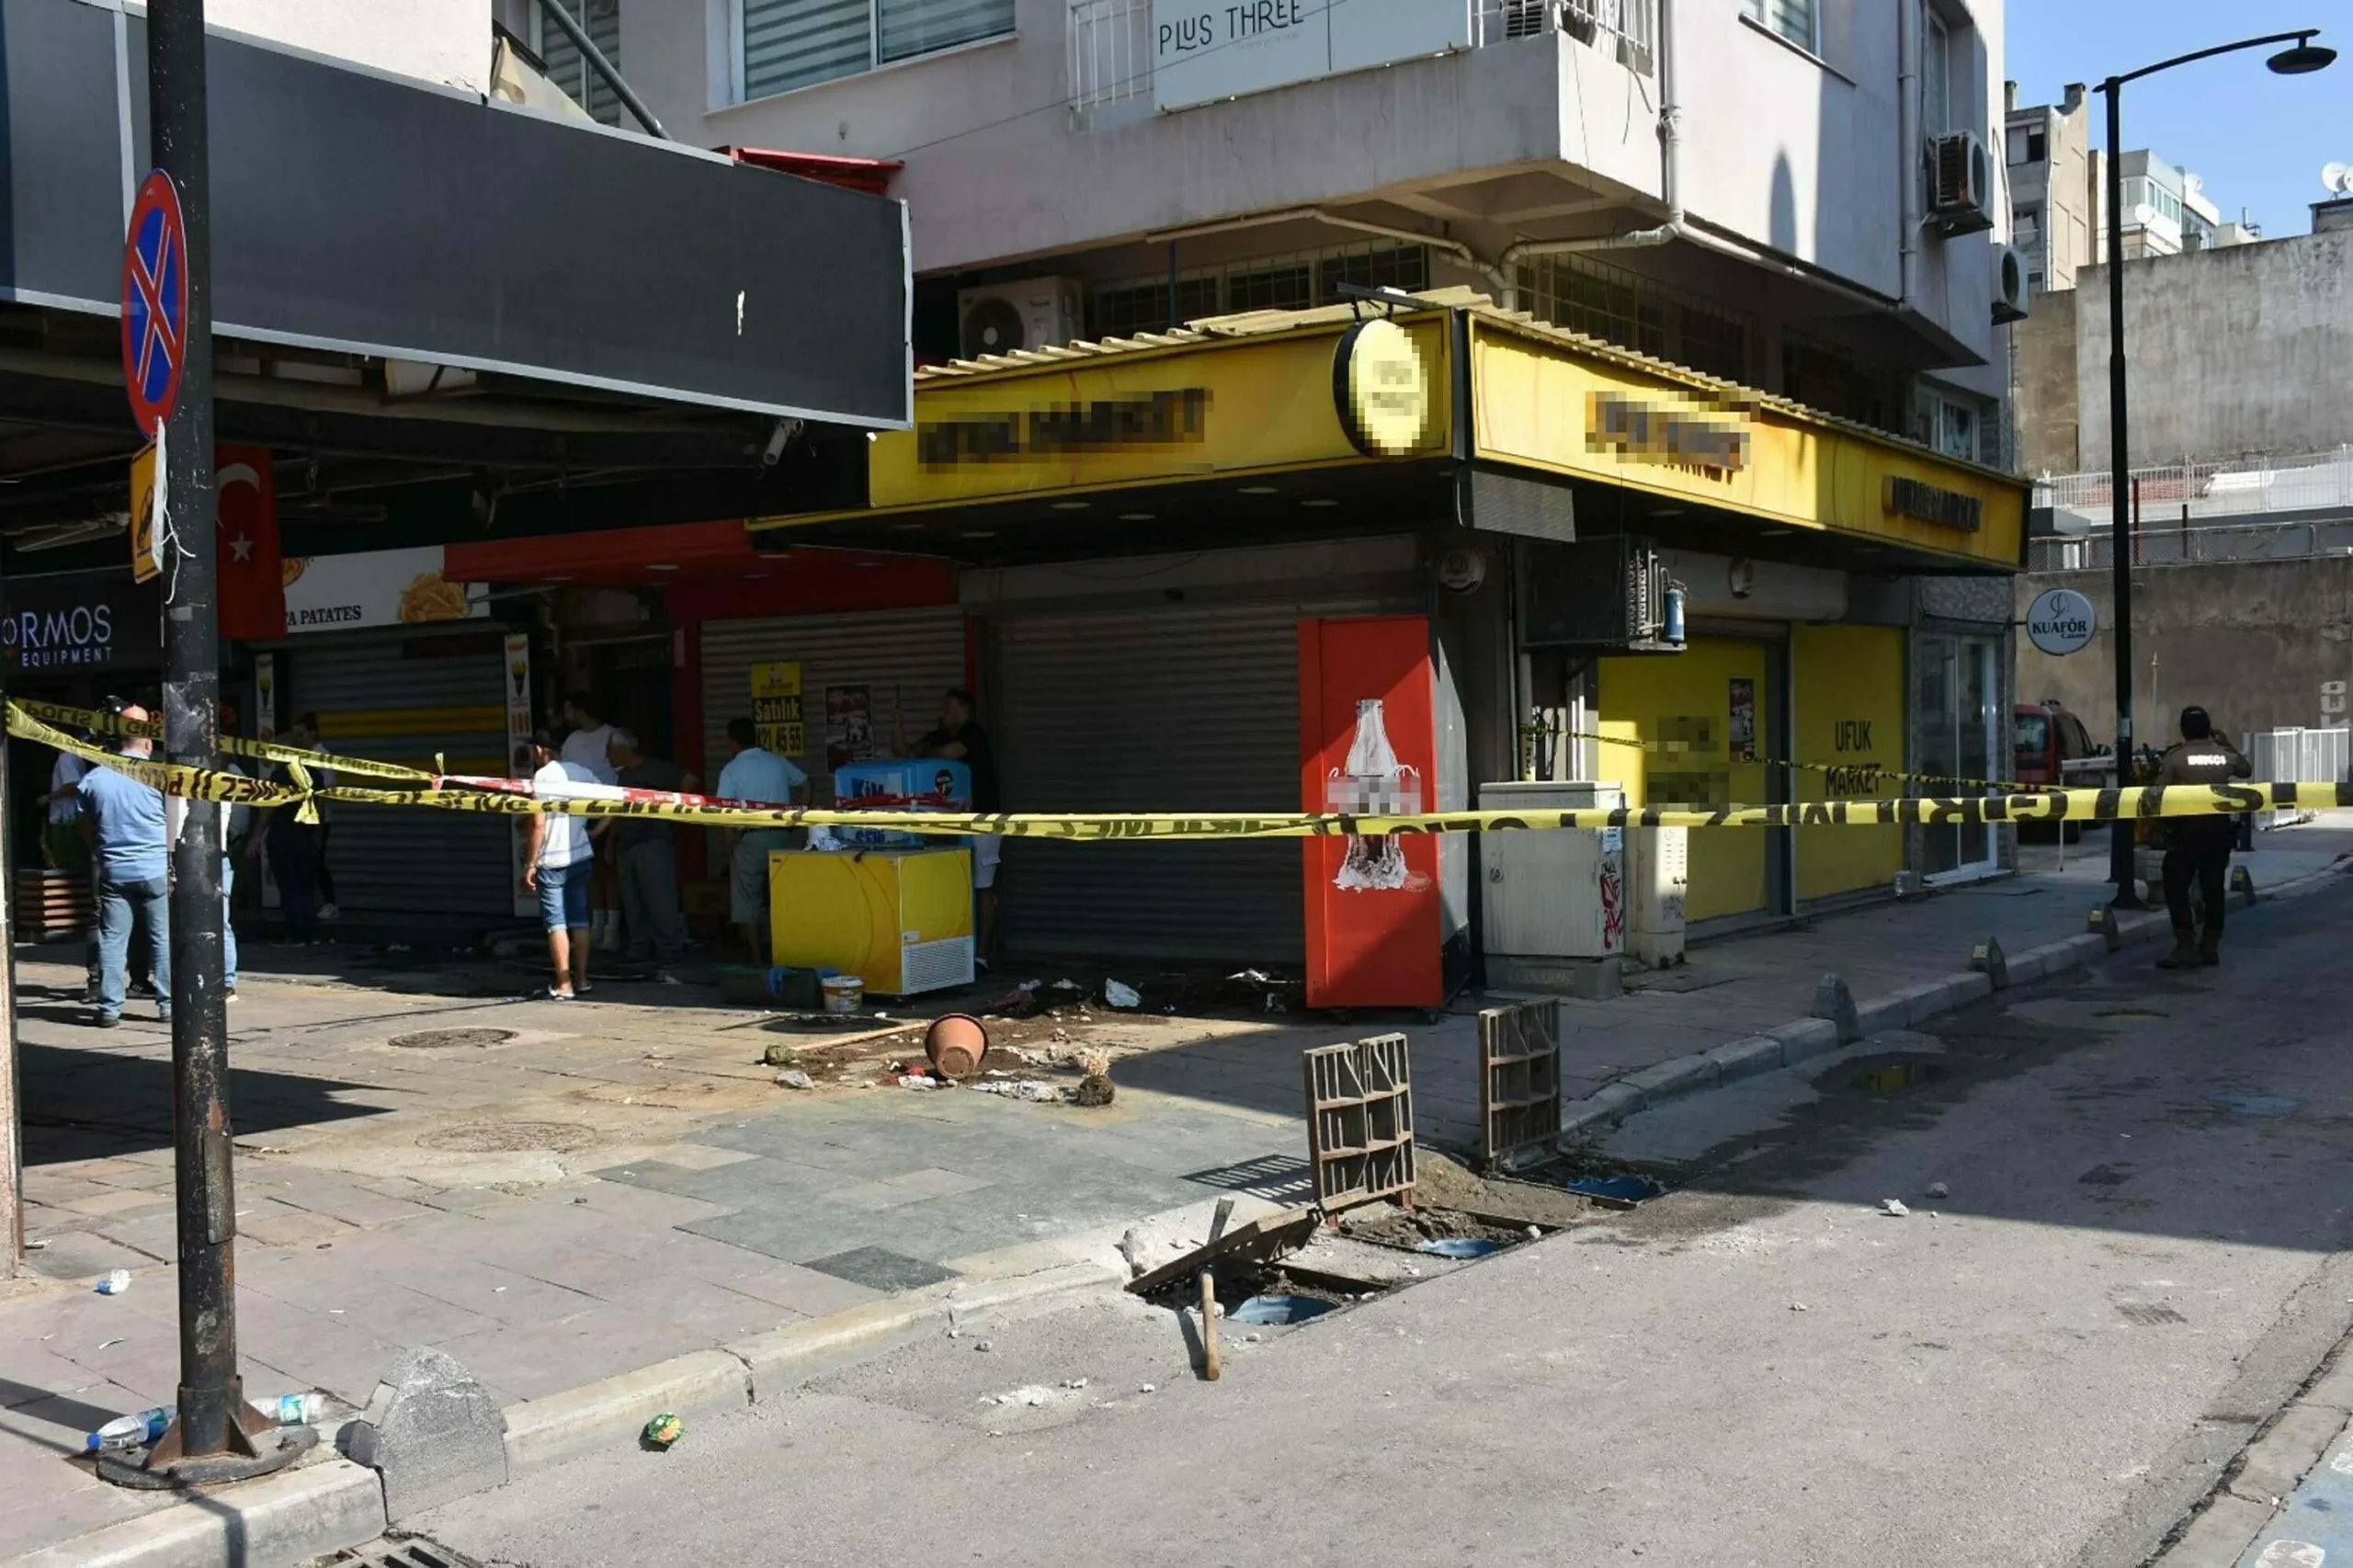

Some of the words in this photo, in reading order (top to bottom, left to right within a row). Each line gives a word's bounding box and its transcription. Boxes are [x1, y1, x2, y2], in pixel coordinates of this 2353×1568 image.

[1160, 14, 1212, 55] PLUS
[1225, 0, 1304, 39] THREE
[300, 605, 362, 625] PATATES
[2031, 618, 2087, 635] KUAFÖR
[22, 647, 112, 668] EQUIPMENT
[1835, 720, 1872, 752] UFUK
[1825, 763, 1881, 797] MARKET
